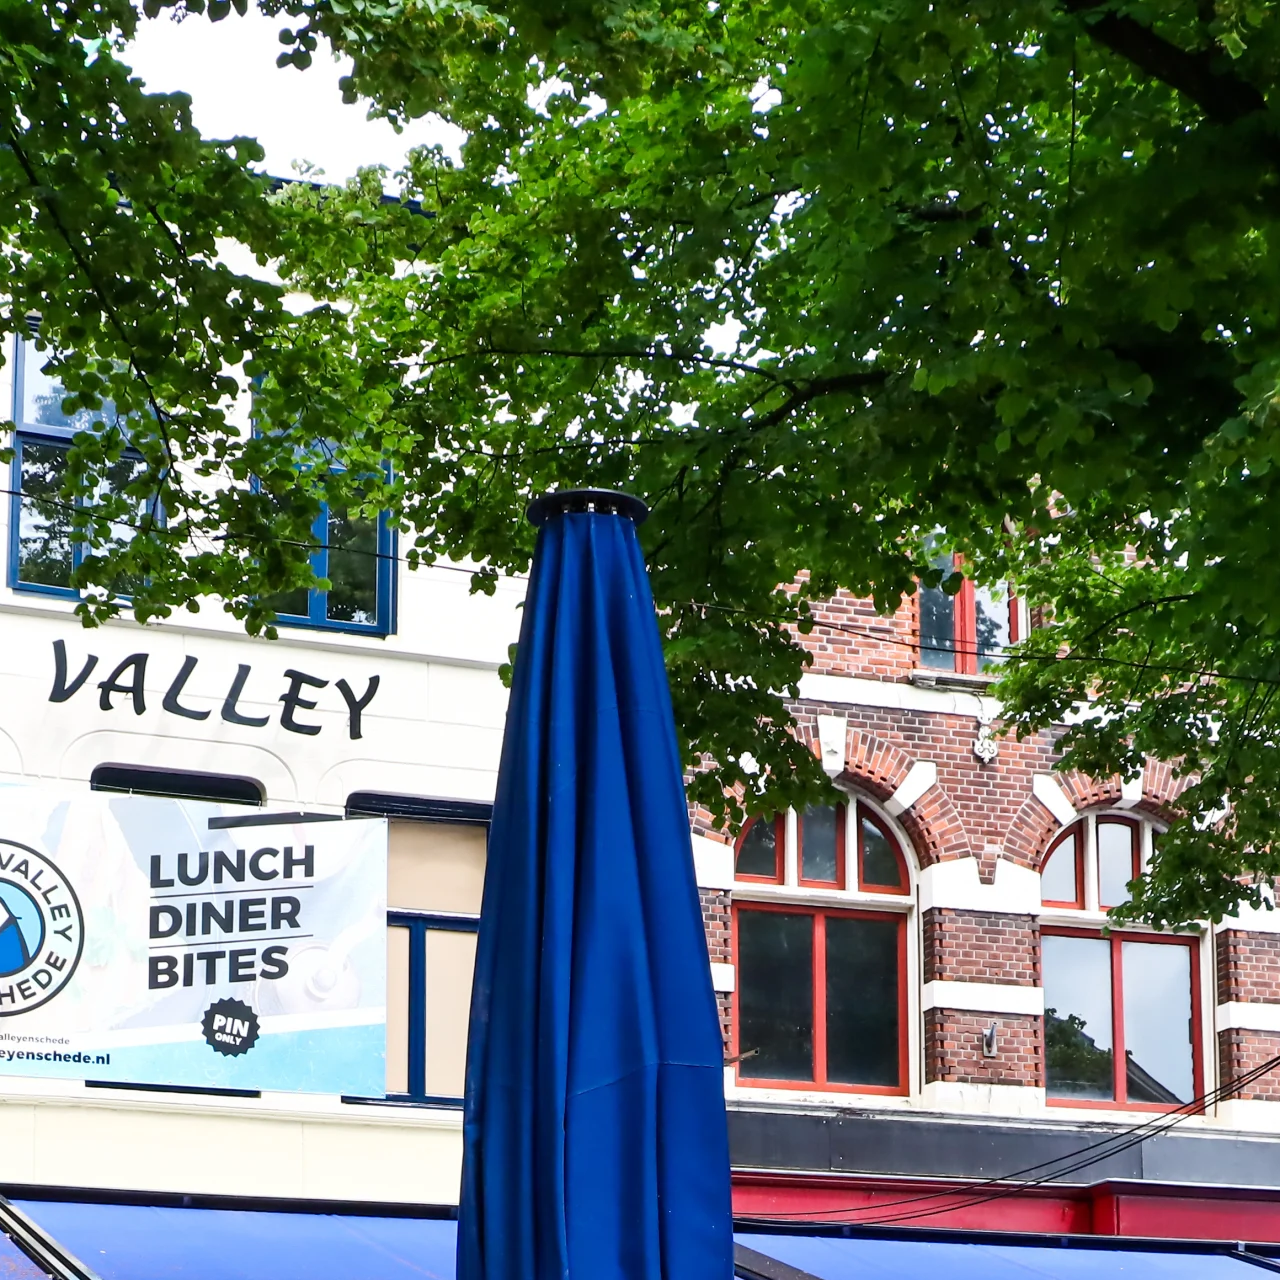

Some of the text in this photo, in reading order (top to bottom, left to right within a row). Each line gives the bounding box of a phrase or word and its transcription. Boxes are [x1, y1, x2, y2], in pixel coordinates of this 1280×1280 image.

[48, 639, 381, 740] VALLEY
[150, 845, 314, 888] LUNCH
[149, 895, 301, 939] DINER
[148, 945, 289, 990] BITES
[212, 1014, 250, 1038] PIN
[214, 1032, 243, 1046] ONLY
